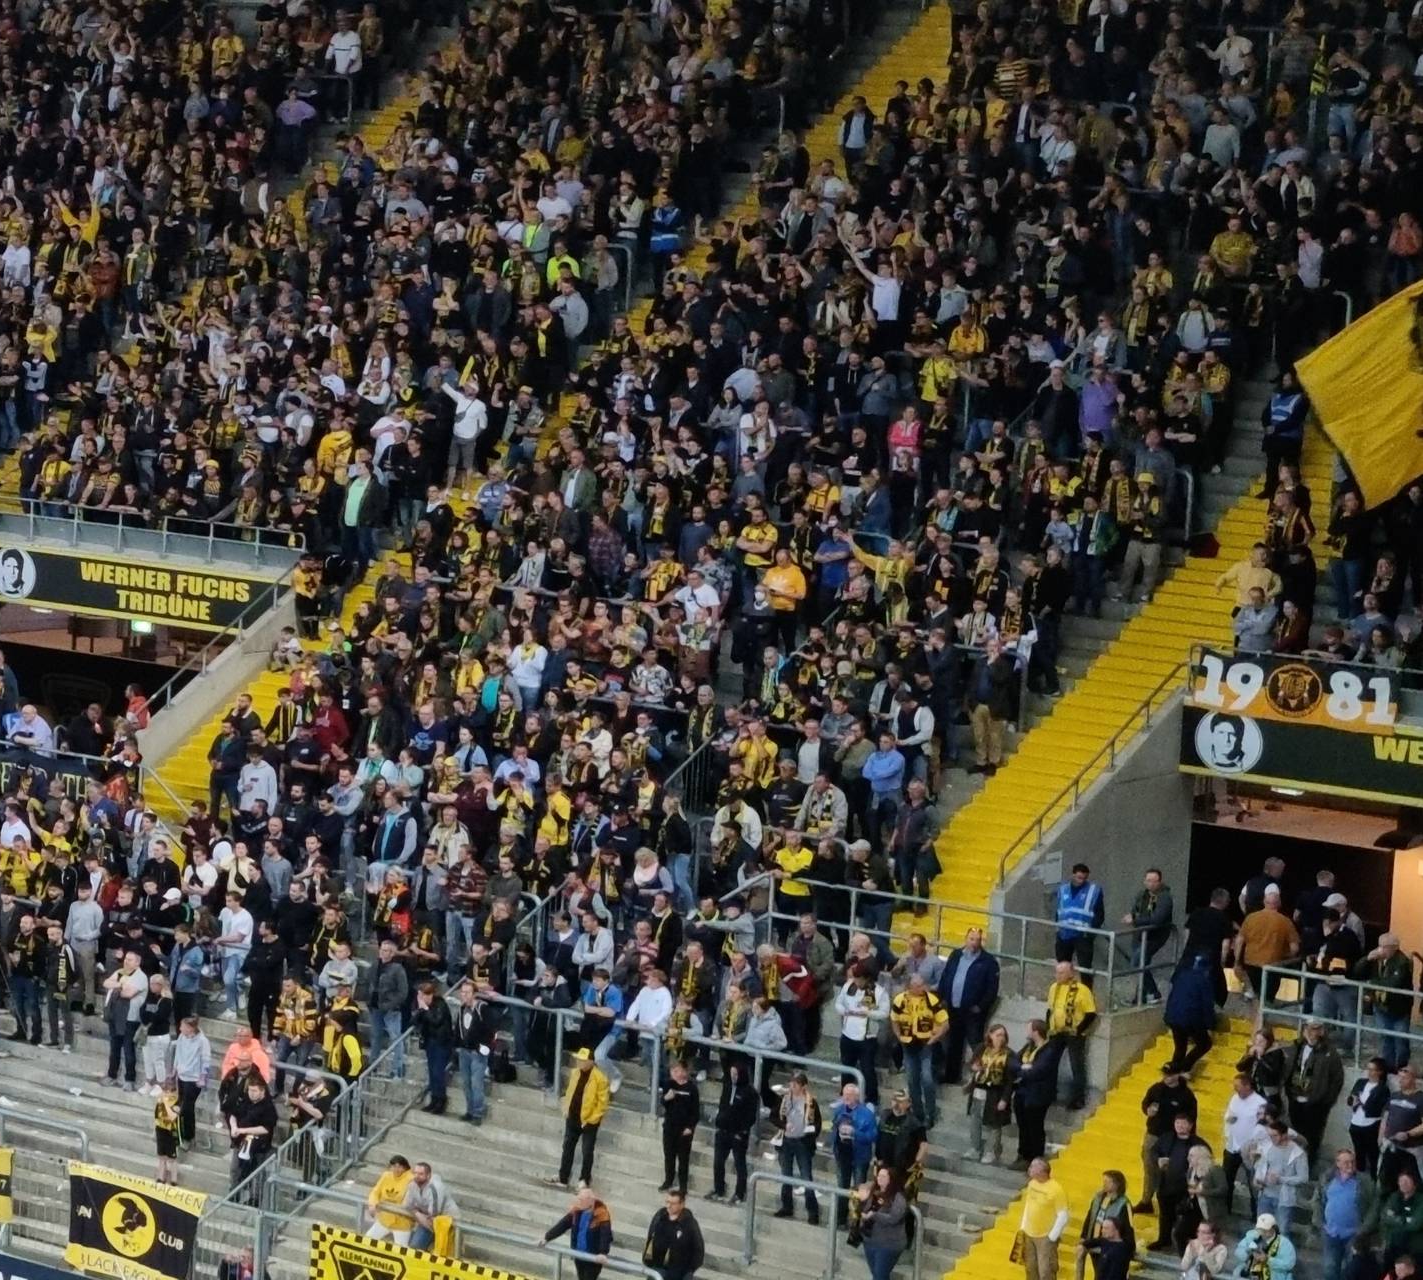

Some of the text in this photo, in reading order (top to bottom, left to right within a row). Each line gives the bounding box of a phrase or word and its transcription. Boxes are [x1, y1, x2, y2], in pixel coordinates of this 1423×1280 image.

[80, 561, 250, 603] WERNER FUCHS
[116, 588, 211, 622] TRIBÜNE
[1194, 654, 1397, 727] 19 81
[338, 1249, 396, 1273] ALEMANNIA
